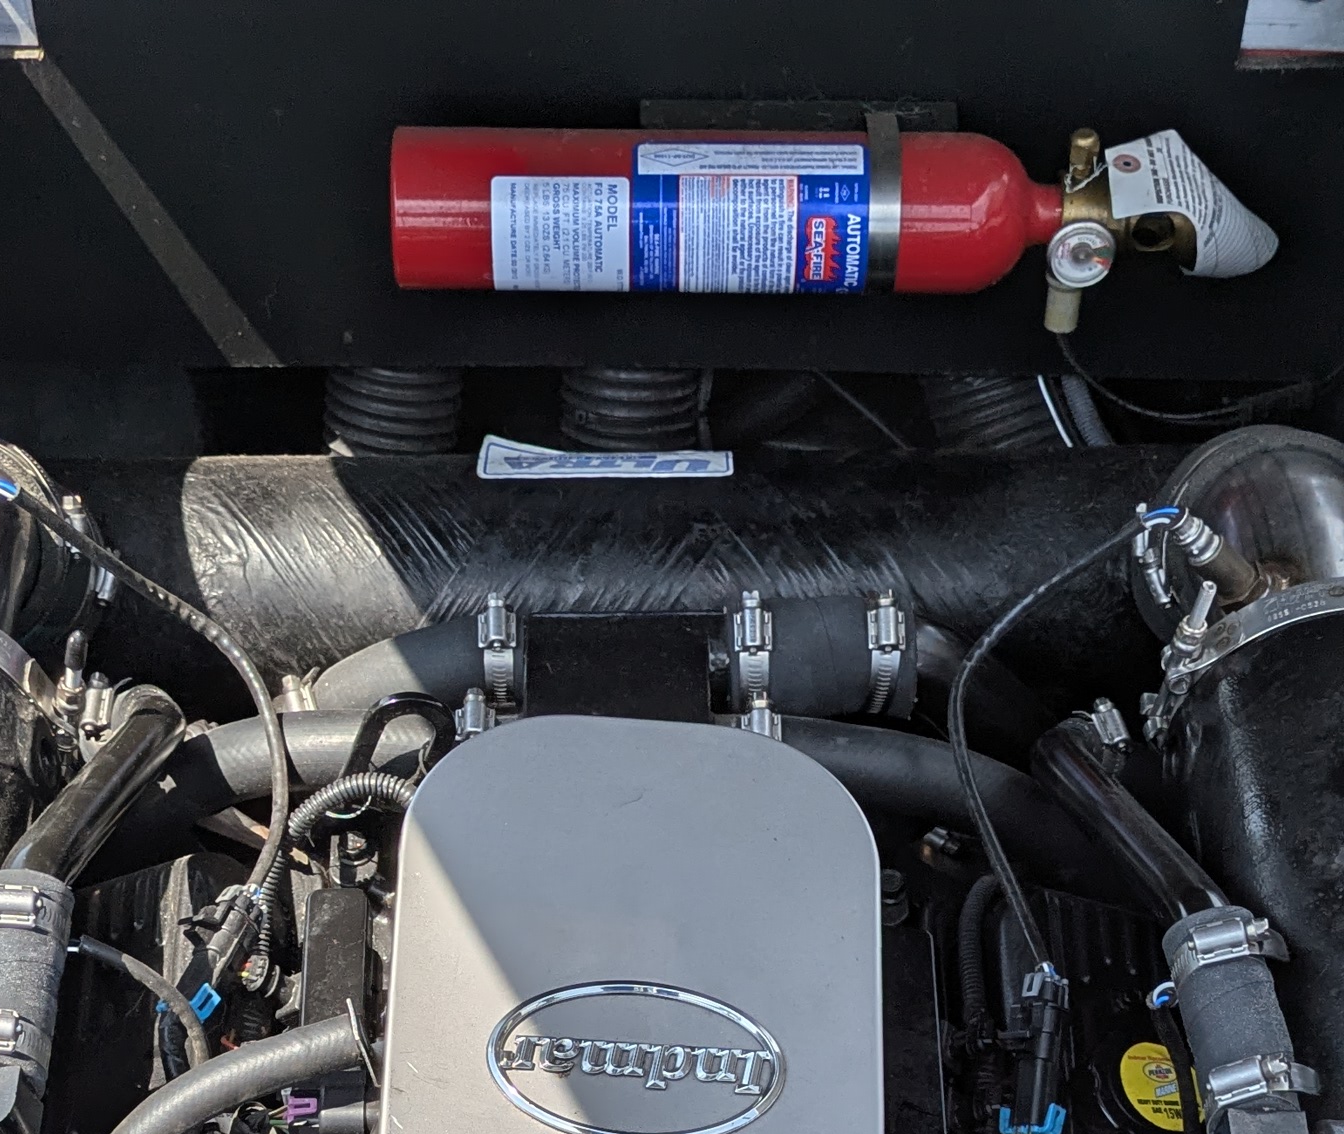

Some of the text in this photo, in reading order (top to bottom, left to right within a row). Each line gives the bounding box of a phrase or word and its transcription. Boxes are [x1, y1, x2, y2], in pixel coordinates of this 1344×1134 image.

[563, 184, 569, 193] 75
[572, 183, 580, 226] MAXIMUM
[607, 184, 618, 232] MODEL
[543, 212, 549, 221] 13
[594, 182, 603, 272] FG 75A AUTOMATIC
[746, 223, 755, 261] Unnecessary
[785, 224, 793, 253] discharge
[844, 214, 861, 286] AUTOMATIC
[501, 1035, 770, 1095] Indmar
